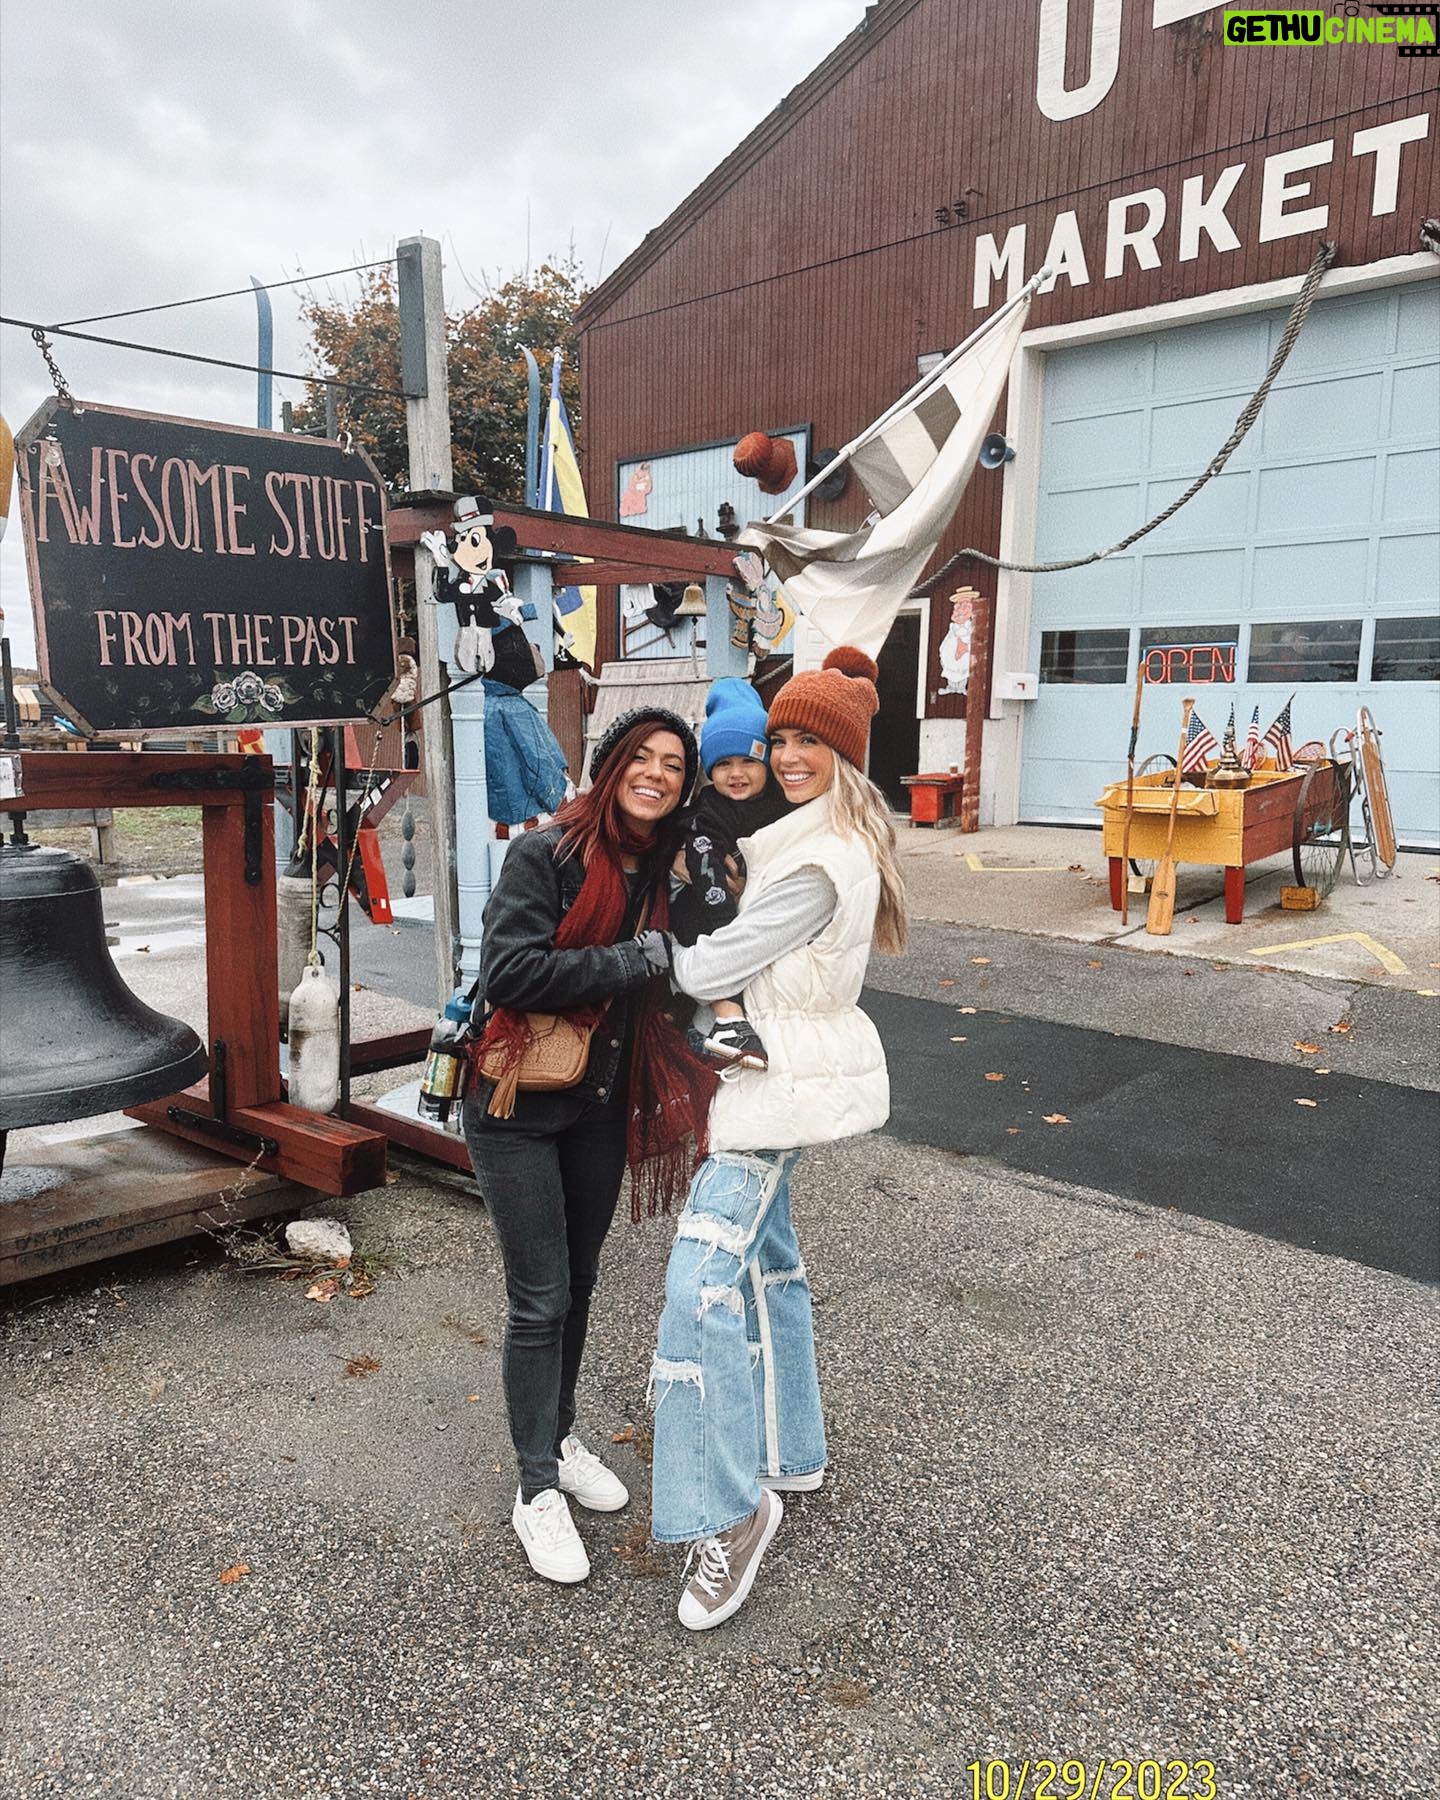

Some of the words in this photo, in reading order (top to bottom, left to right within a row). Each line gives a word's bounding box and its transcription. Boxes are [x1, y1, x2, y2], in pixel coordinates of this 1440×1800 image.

[972, 113, 1430, 310] MARKET
[28, 439, 256, 556] AWESOME
[264, 471, 377, 563] STUFF
[95, 611, 197, 667] FROM
[203, 612, 278, 666] THE
[281, 615, 358, 666] PAST
[1146, 646, 1236, 684] OPEN
